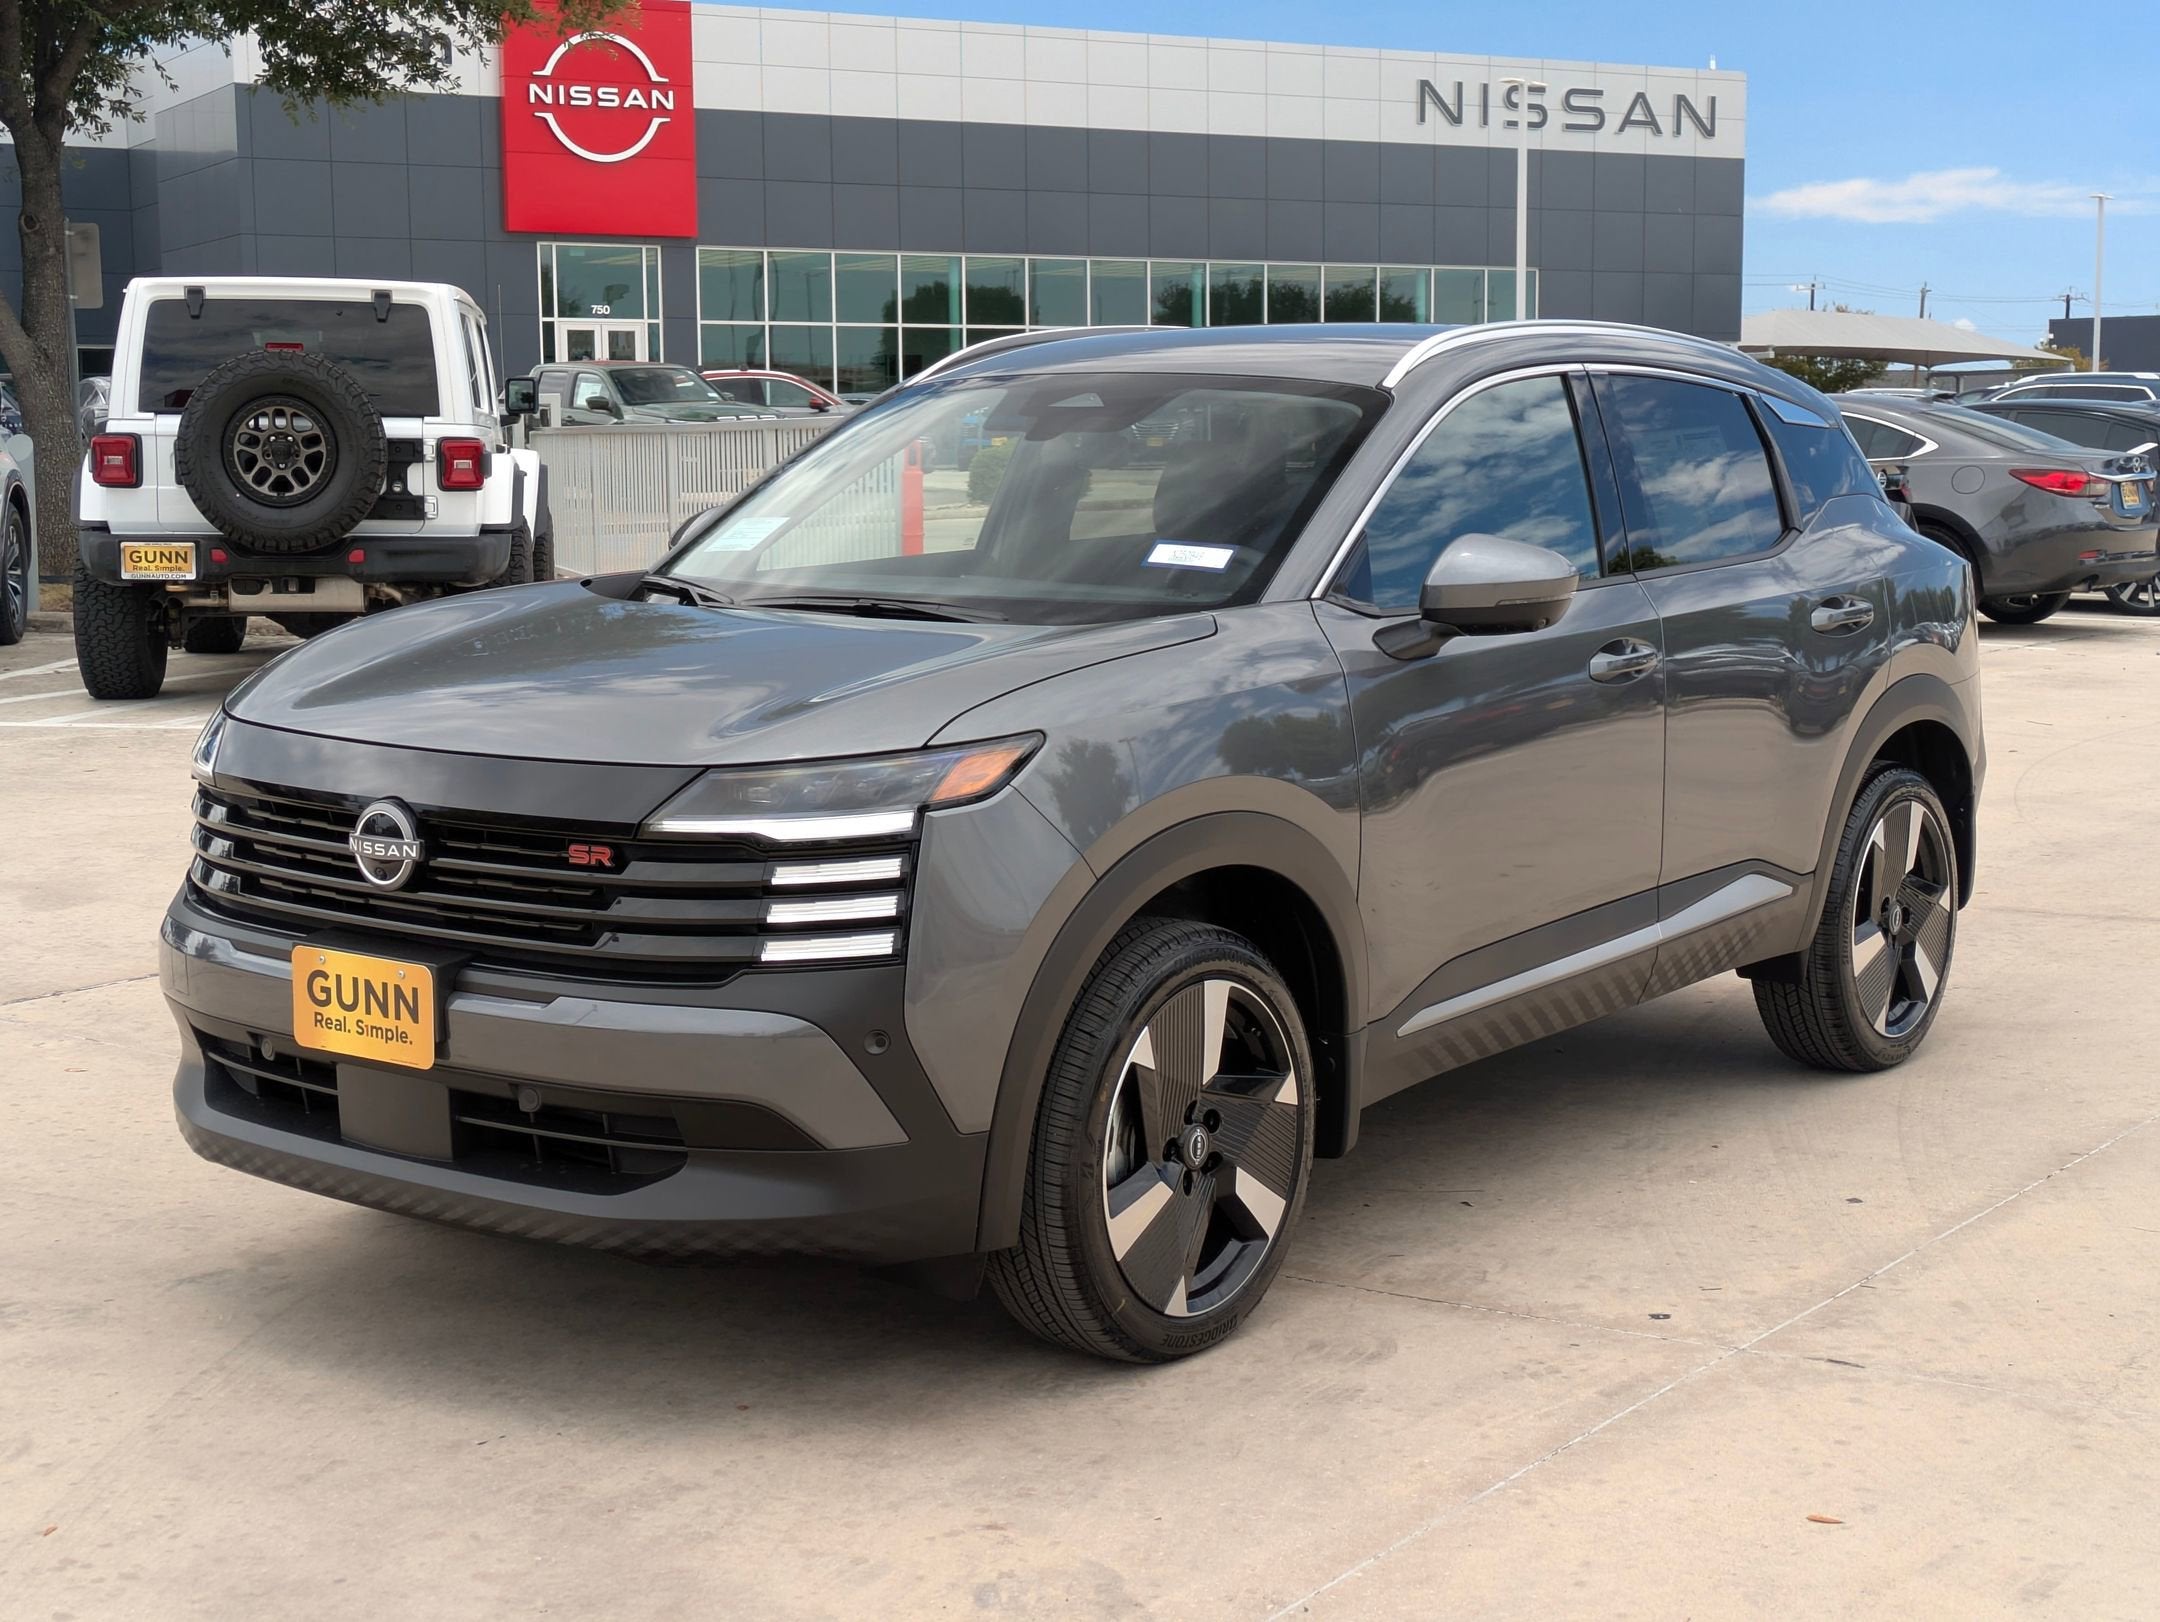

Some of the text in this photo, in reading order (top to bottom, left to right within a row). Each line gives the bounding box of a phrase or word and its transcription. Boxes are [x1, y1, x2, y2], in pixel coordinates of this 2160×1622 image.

[528, 83, 675, 110] NISSAN
[1416, 79, 1717, 138] NISSAN
[591, 304, 610, 314] 750
[129, 550, 188, 564] GUNN
[349, 836, 417, 858] NISSAN
[568, 844, 614, 867] SR
[306, 969, 420, 1025] GUNN
[314, 1011, 351, 1034] Real.
[1161, 1313, 1238, 1349] BRIDGESTONE
